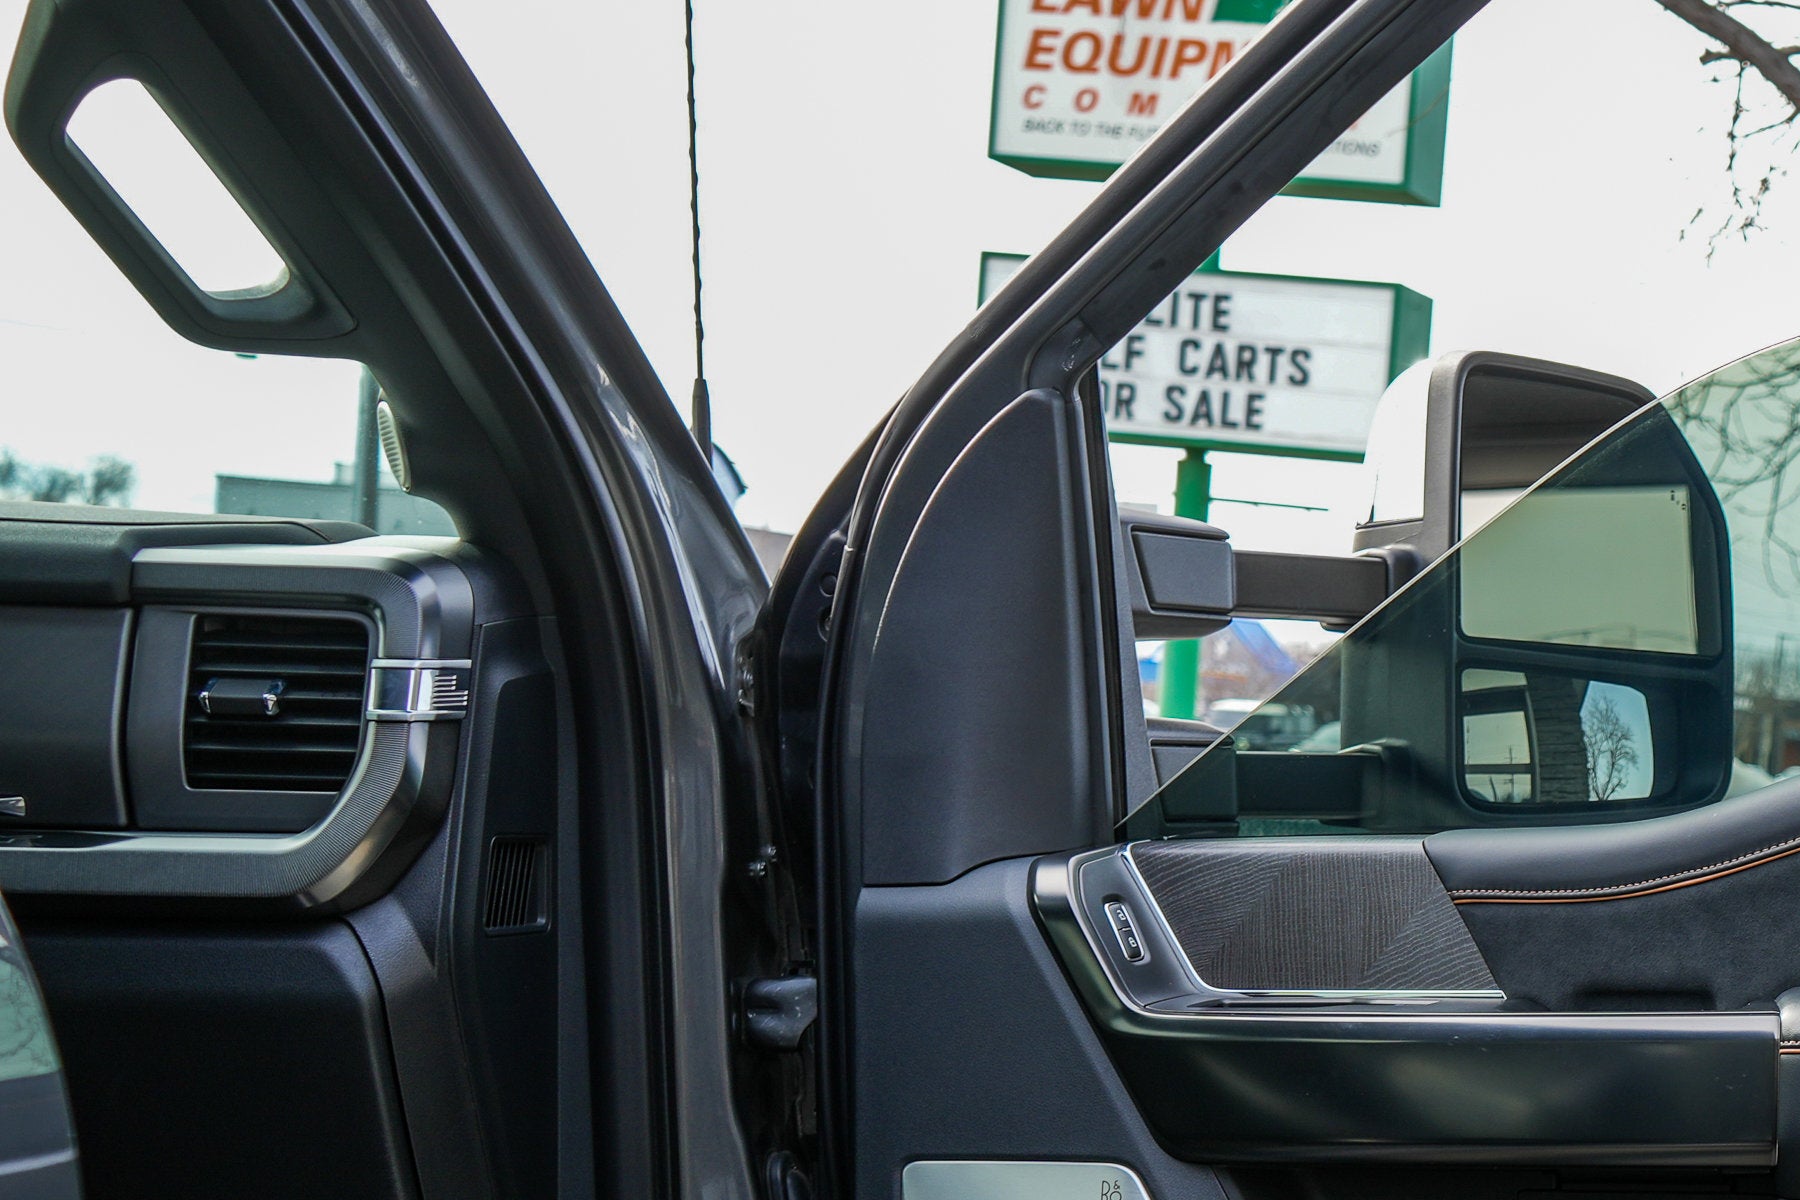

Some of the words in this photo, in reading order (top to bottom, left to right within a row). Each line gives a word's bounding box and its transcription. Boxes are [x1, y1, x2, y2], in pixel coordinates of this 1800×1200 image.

[1022, 118, 1065, 135] BACK
[1070, 120, 1092, 137] TO
[1096, 121, 1123, 139] THE
[1178, 338, 1312, 386] CARTS
[1163, 384, 1266, 431] SALE
